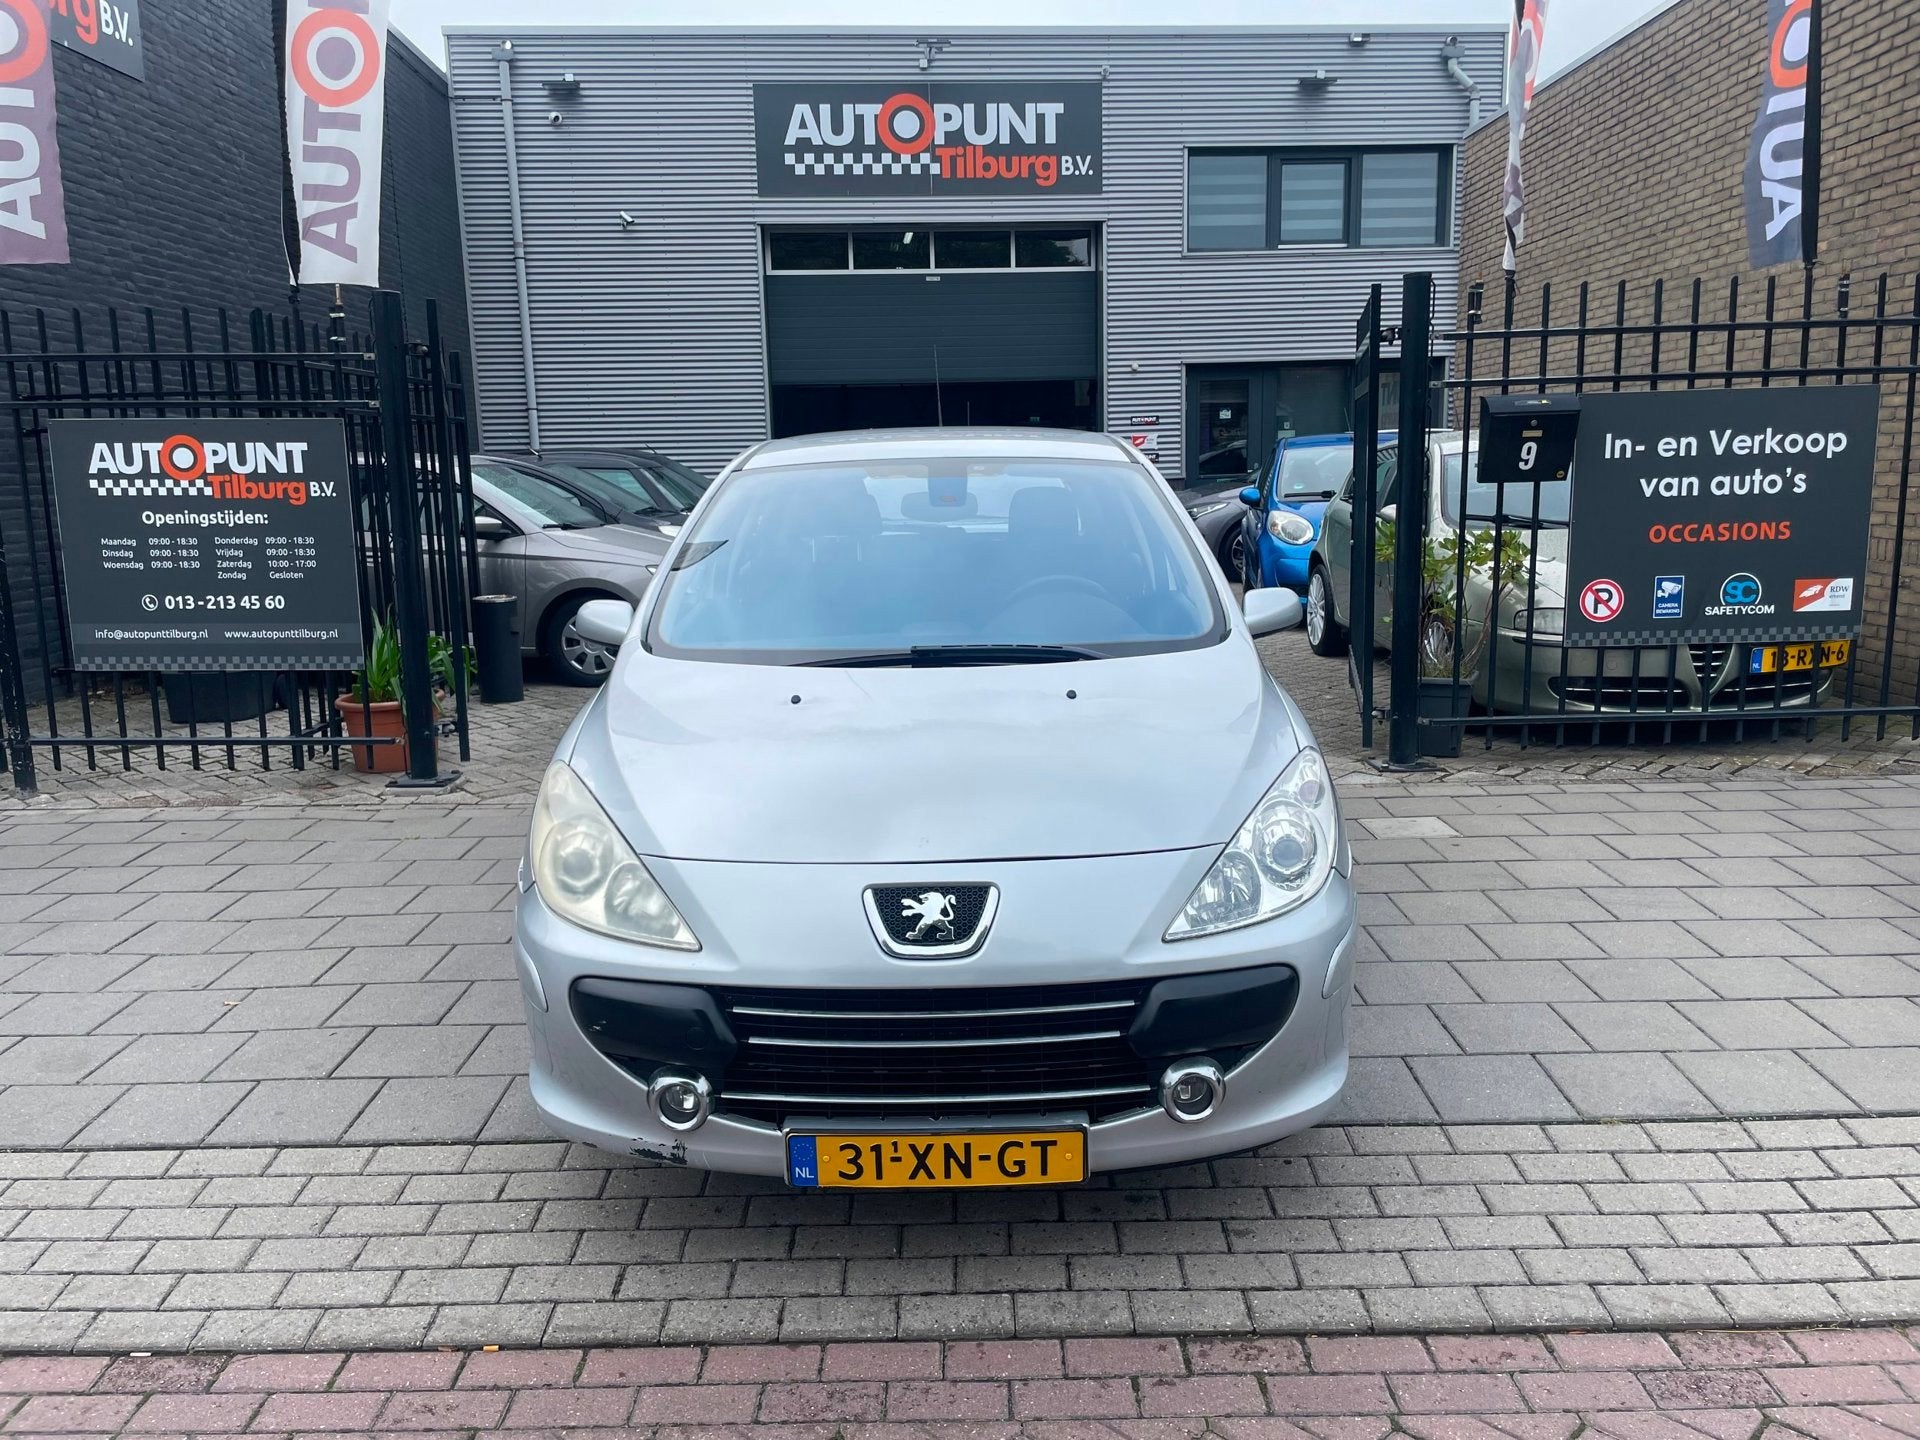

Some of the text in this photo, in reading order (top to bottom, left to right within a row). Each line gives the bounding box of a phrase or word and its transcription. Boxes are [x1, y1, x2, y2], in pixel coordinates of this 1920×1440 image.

[784, 93, 1064, 154] AUTOPUNT
[290, 0, 381, 264] AUTO
[935, 146, 1093, 186] Tilburg B.V.
[1604, 428, 1847, 459] In- en Verkoop
[89, 434, 307, 480] AUTOPUNT
[1519, 442, 1537, 470] 9
[1640, 468, 1807, 497] van auto's
[207, 475, 336, 505] Tilburg B.V.
[142, 510, 268, 527] Openingstijden:
[1649, 521, 1791, 543] OCCASIONS
[101, 538, 136, 546] Maandag
[215, 537, 258, 545] Donderdag
[103, 550, 133, 558] Dinsdag
[216, 549, 243, 557] Vrijdag
[104, 562, 143, 570] Woensdag
[217, 561, 251, 569] Zaterdag
[268, 560, 289, 568] 10:00
[296, 560, 316, 568] 17:00
[218, 571, 303, 580] Zondag Gesloten
[241, 596, 260, 609] 45
[265, 596, 285, 609] 60
[1705, 604, 1775, 616] SAFETYCOM
[95, 629, 338, 640] info@autopunttilburg.nl www.autopunttilburg.nl
[796, 1167, 814, 1178] NL
